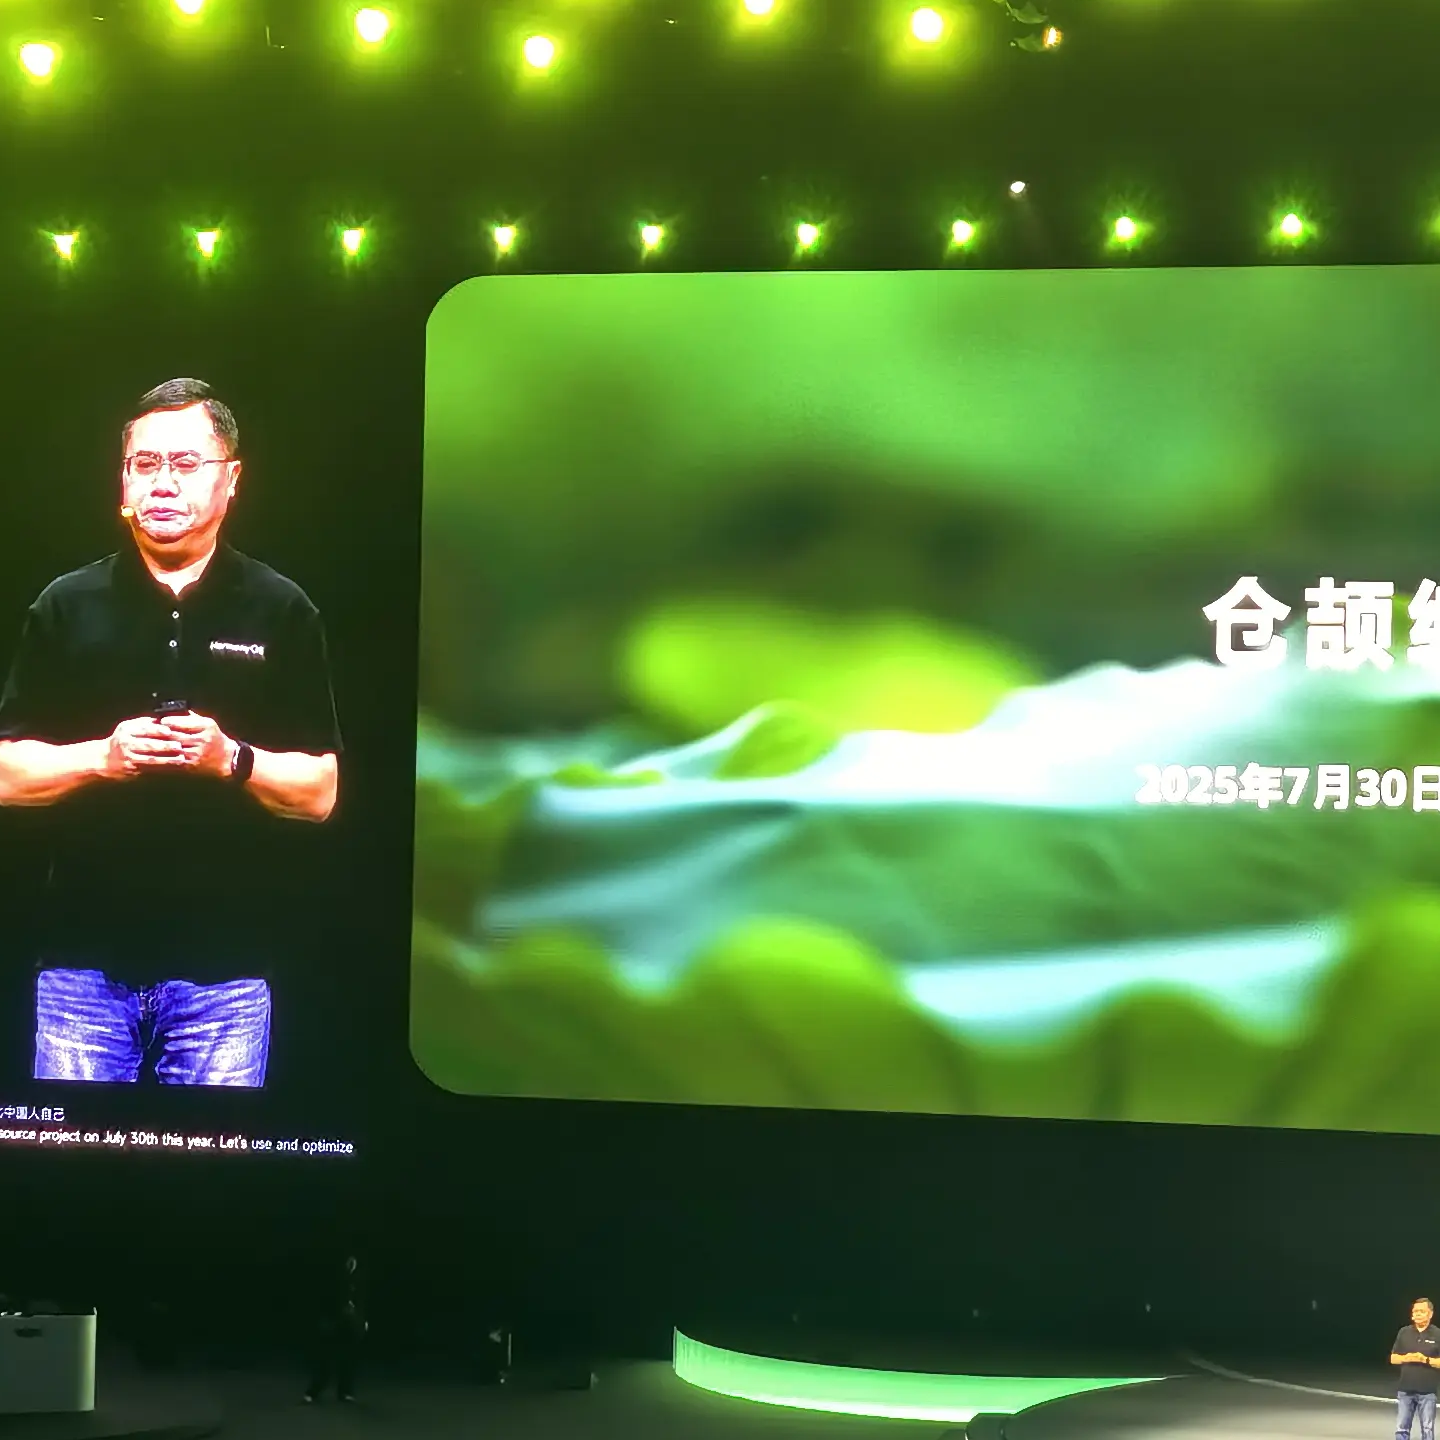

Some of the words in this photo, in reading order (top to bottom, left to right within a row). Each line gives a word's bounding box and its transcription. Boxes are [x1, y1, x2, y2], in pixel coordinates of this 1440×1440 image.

[39, 1129, 81, 1144] project
[84, 1133, 100, 1143] on
[130, 1131, 158, 1145] 30th
[162, 1133, 183, 1146] this
[276, 1138, 298, 1151] and
